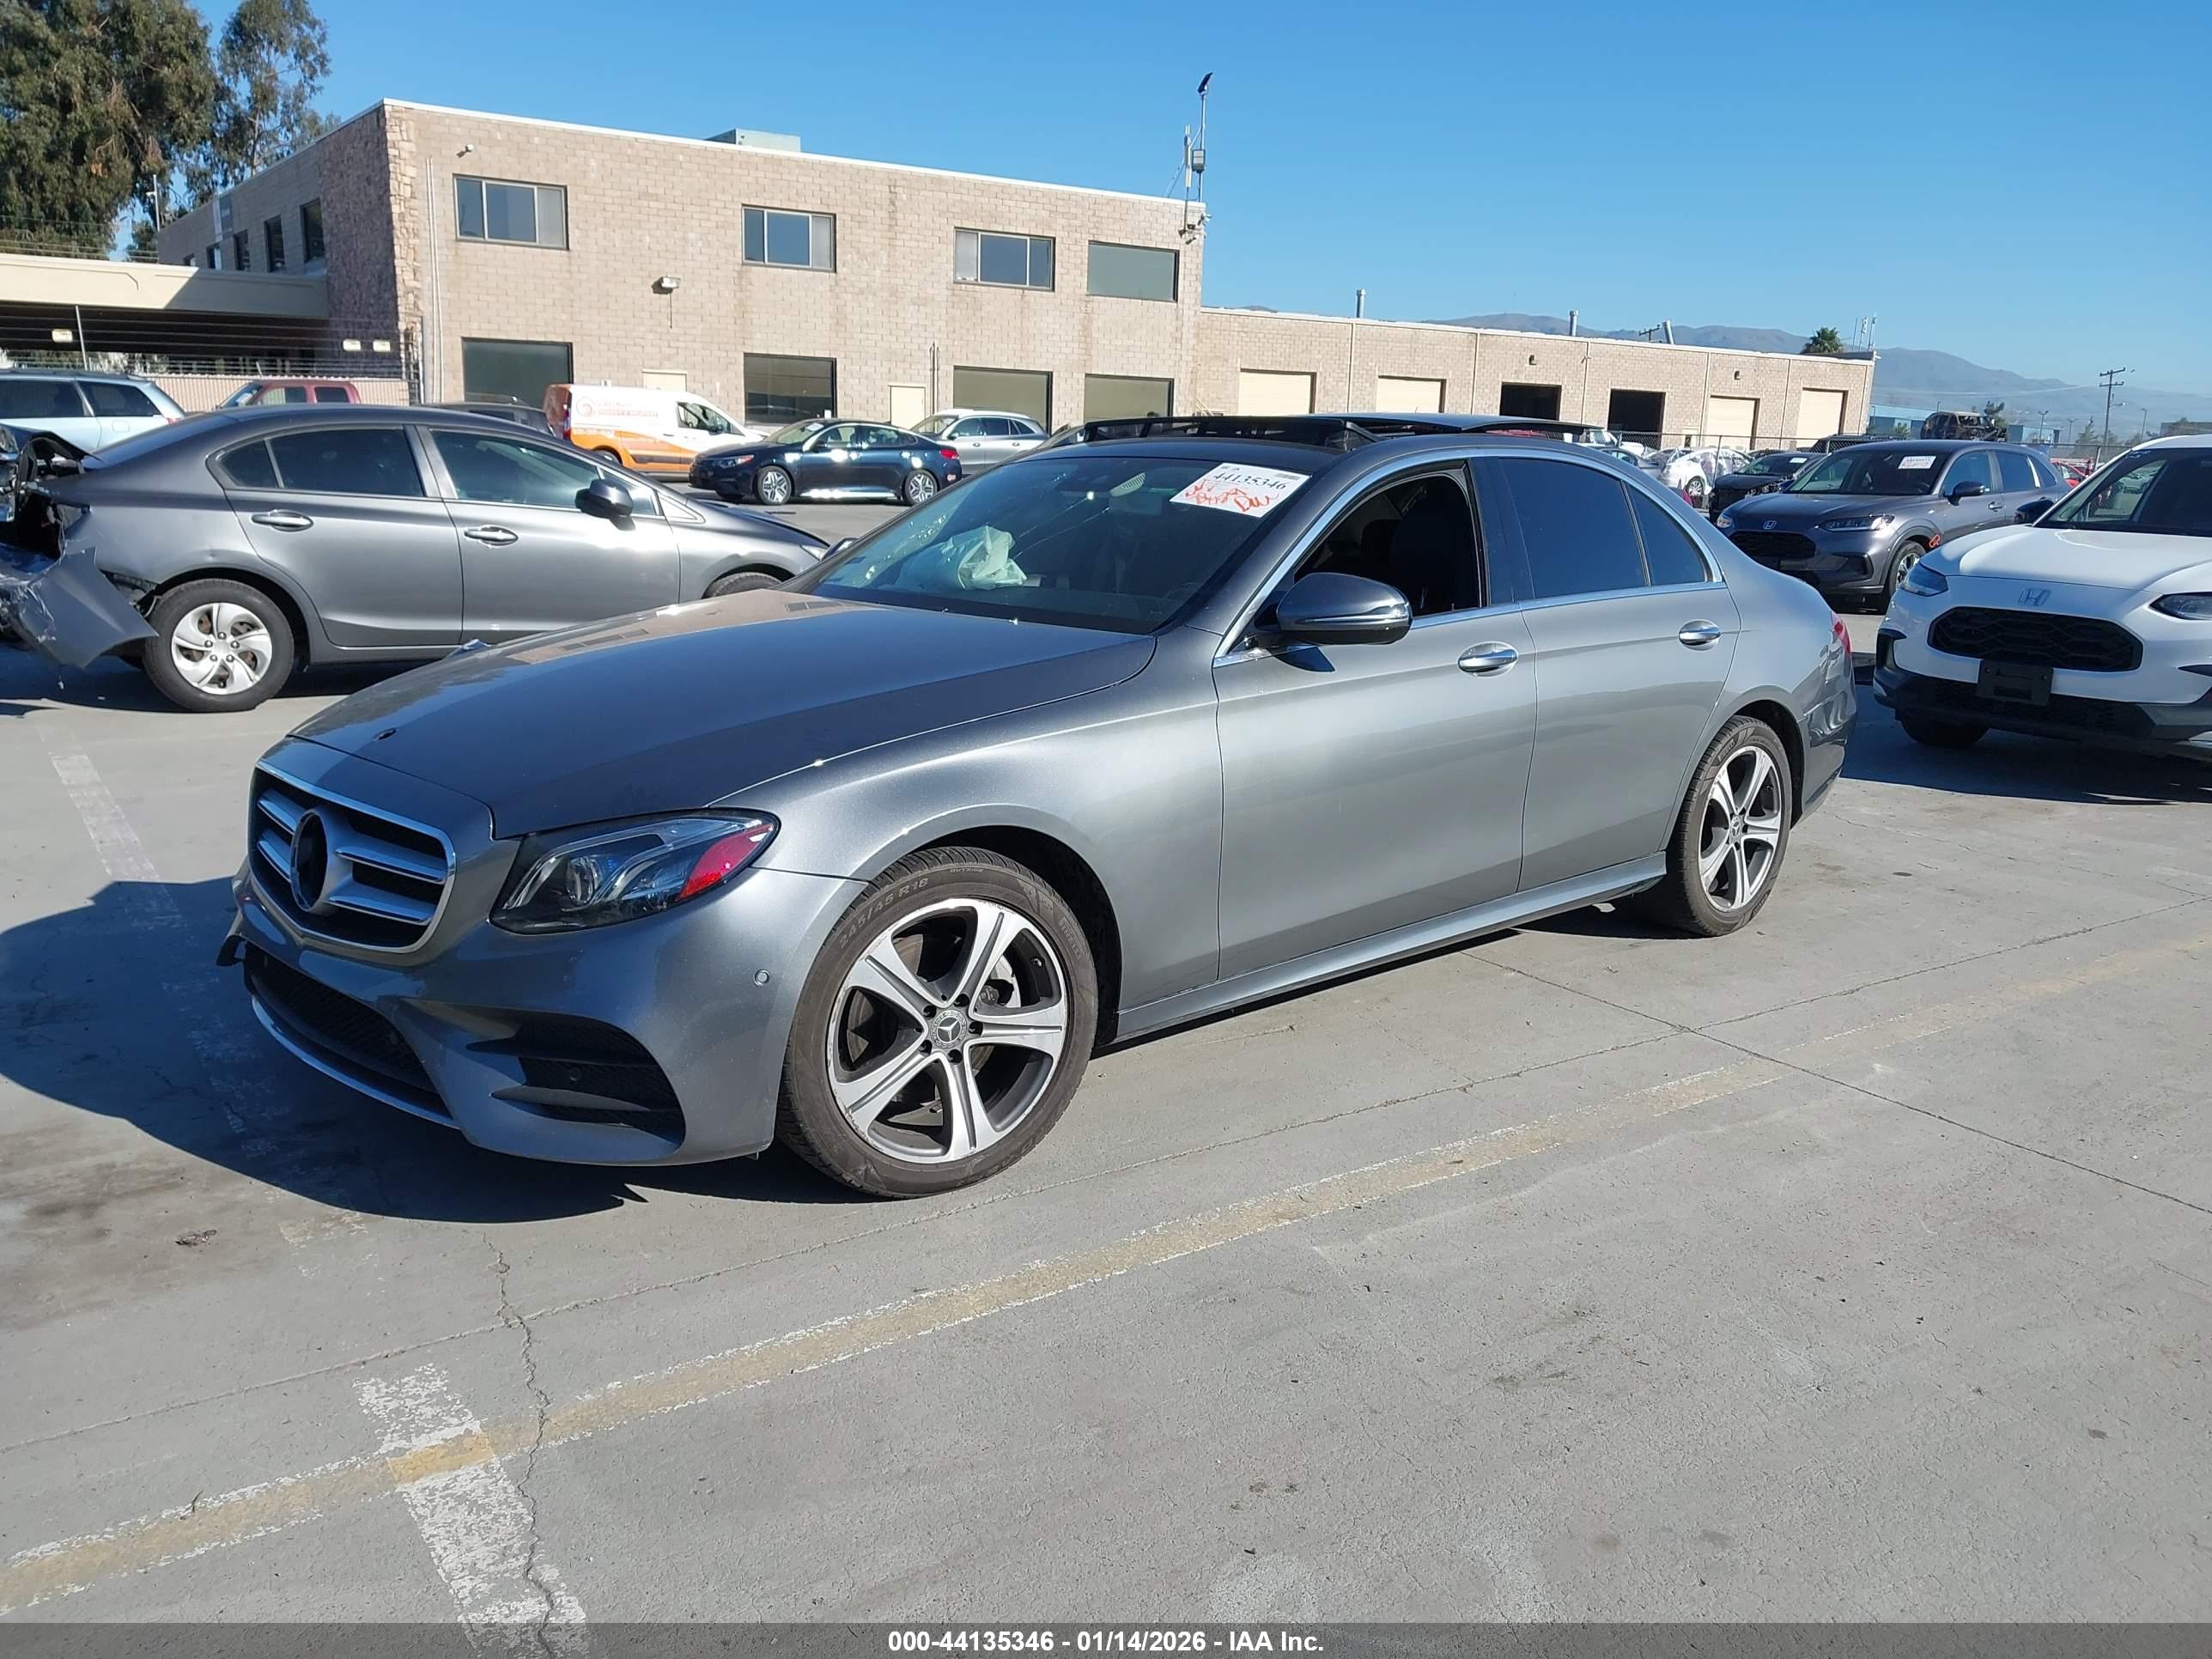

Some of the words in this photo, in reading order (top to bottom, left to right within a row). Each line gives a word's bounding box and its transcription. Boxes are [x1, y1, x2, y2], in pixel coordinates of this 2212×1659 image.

[1213, 473, 1286, 489] 44135346
[839, 893, 895, 948] 245/45
[898, 878, 929, 898] R18
